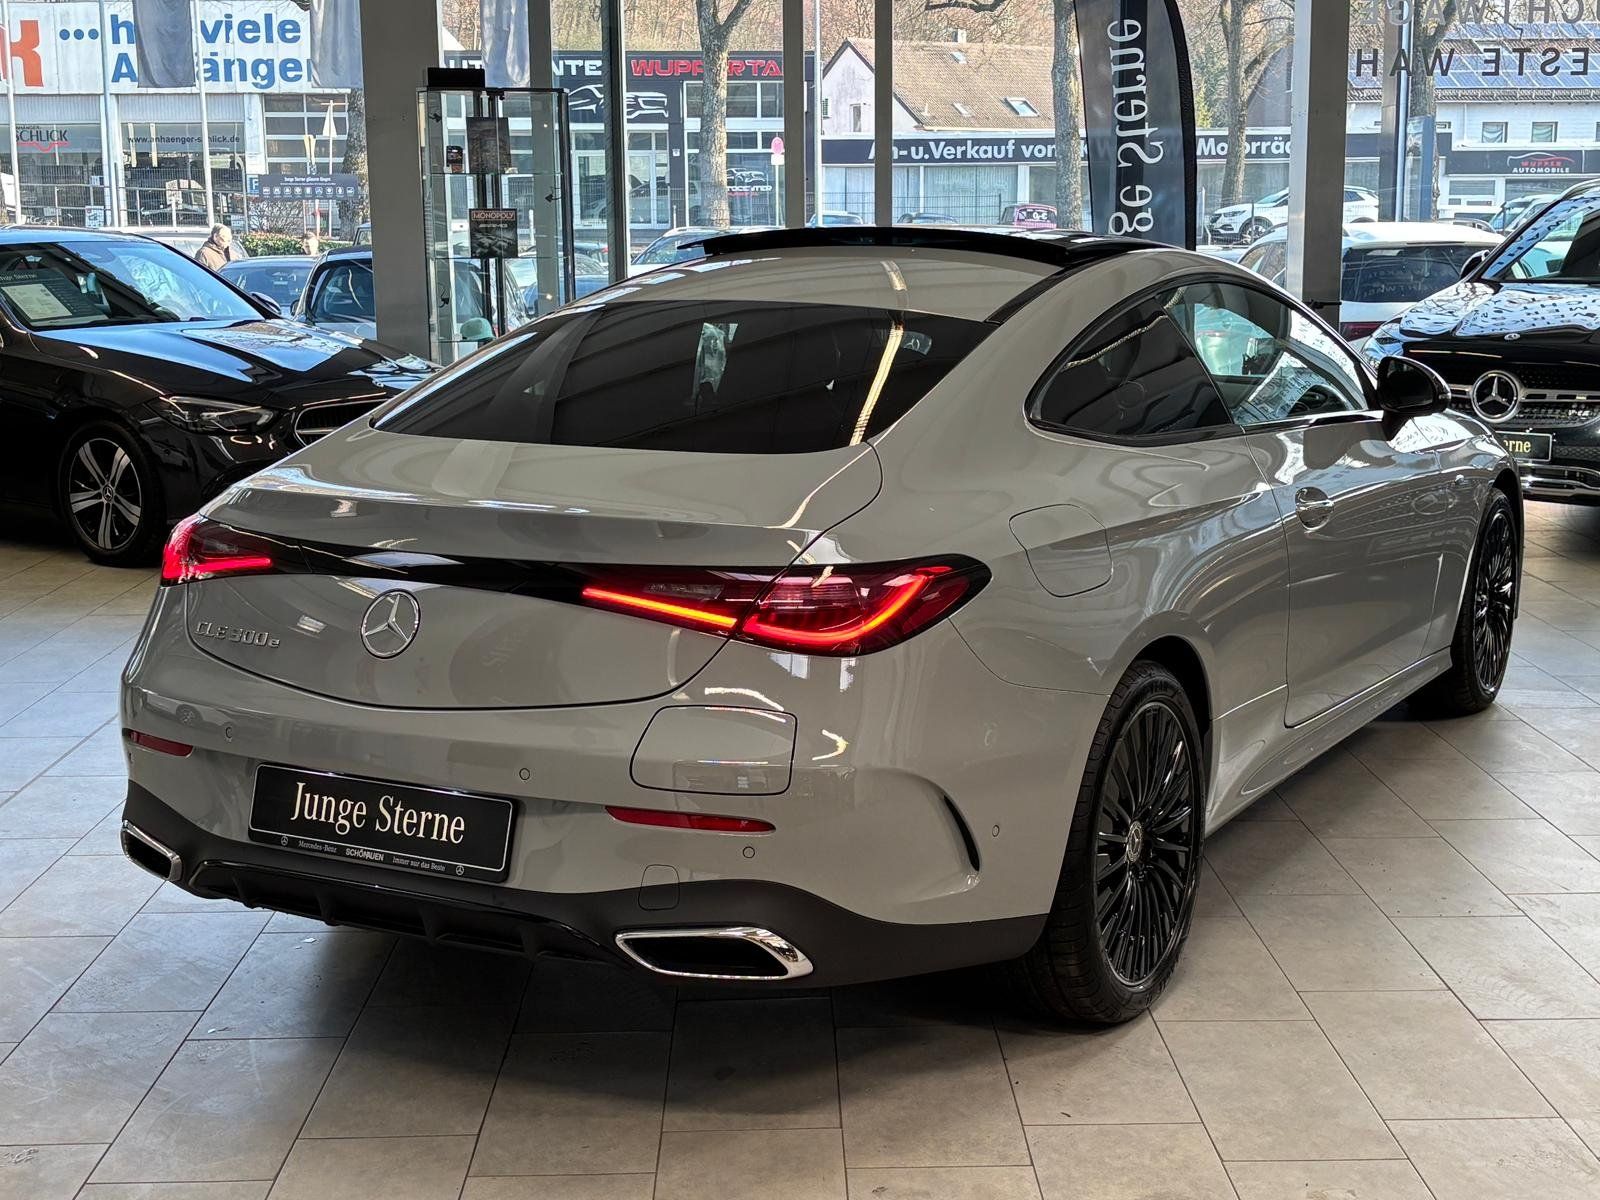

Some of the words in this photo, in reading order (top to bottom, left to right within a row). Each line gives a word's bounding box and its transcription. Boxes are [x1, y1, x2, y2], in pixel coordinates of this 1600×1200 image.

[199, 13, 301, 44] viele
[110, 51, 313, 90] Aänge
[631, 59, 784, 77] WUPPRTA
[127, 134, 240, 145] www.nhaenger-shlick.de
[194, 621, 228, 639] CLE
[229, 627, 281, 648] 300e
[290, 781, 367, 836] Junge
[375, 795, 465, 844] Sterne
[298, 840, 337, 853] Mercedes-Benz
